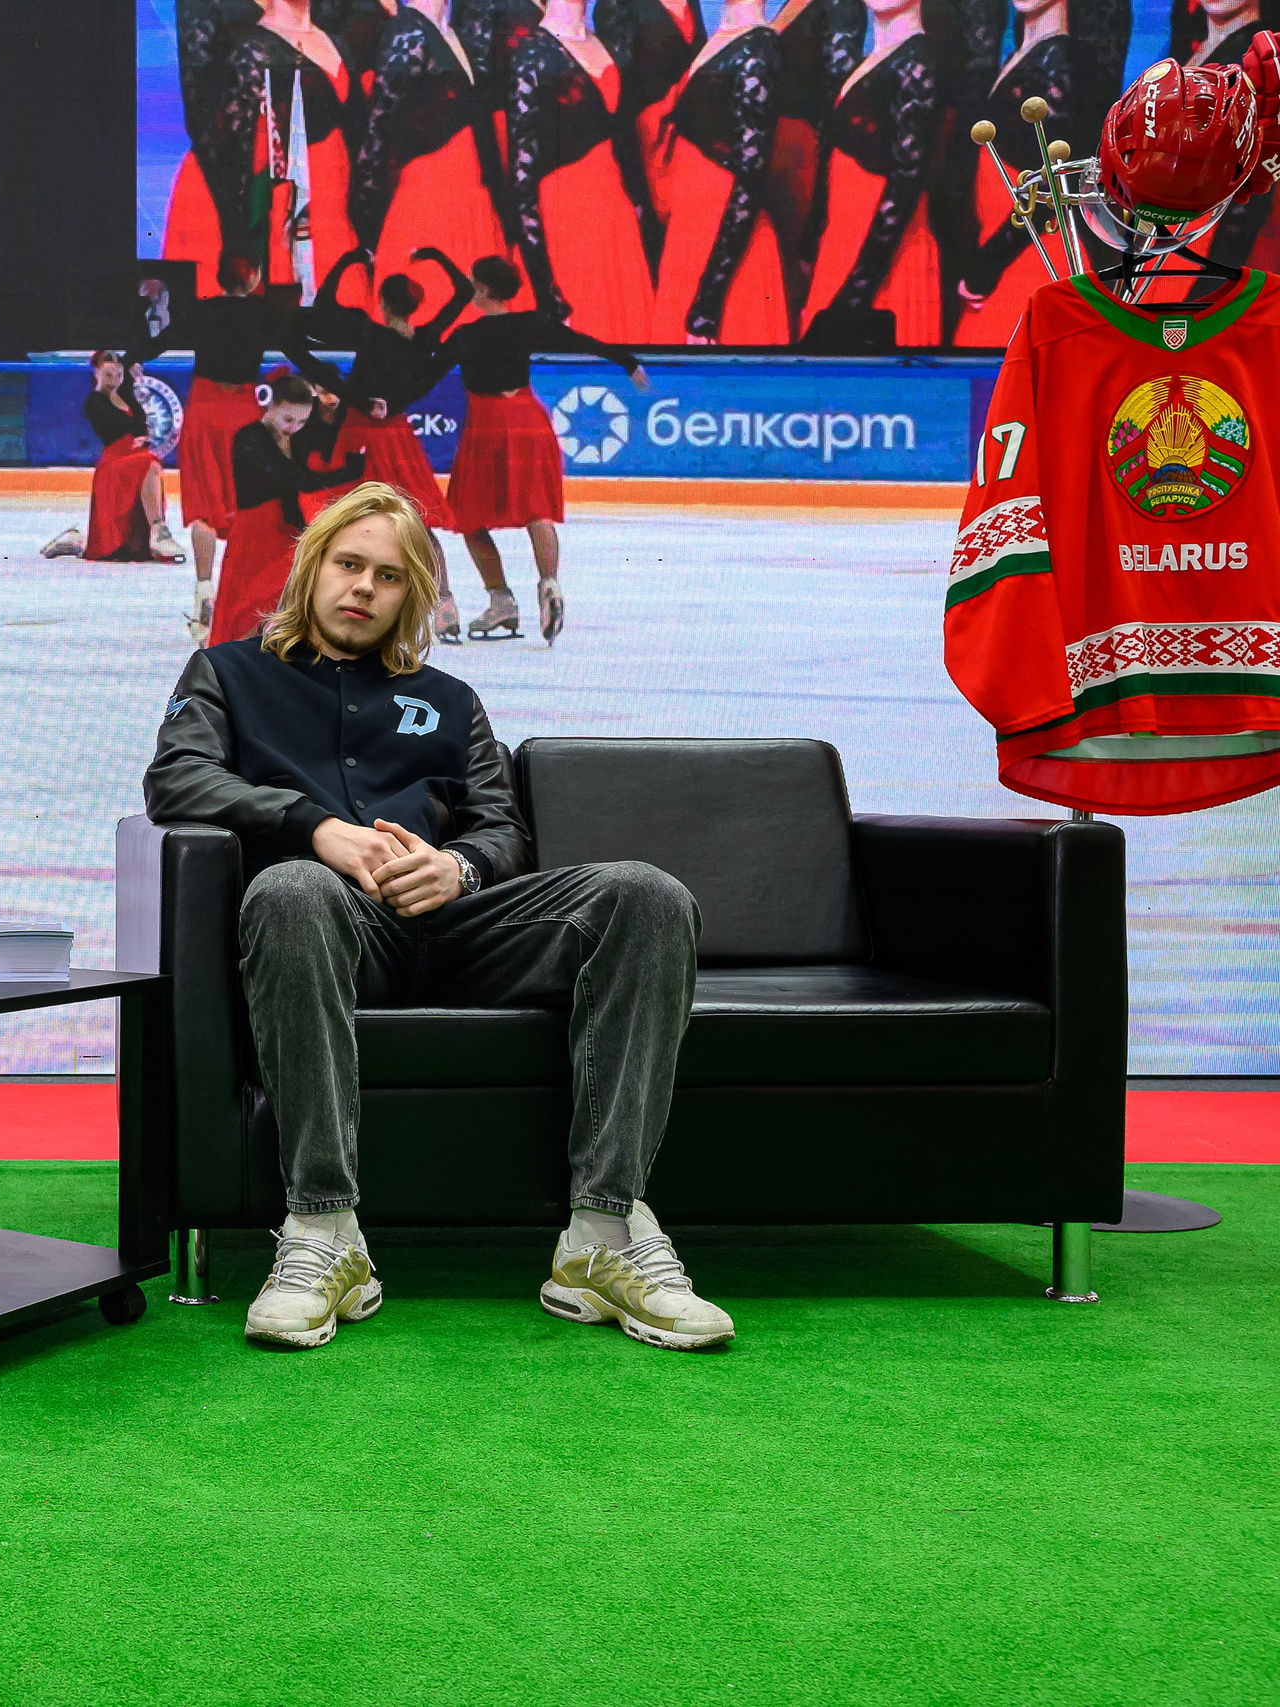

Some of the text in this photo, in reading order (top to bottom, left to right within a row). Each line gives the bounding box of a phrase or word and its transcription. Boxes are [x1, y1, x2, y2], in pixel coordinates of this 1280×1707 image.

[1144, 82, 1162, 139] CCM
[1136, 208, 1194, 222] HOCKEY.BY
[647, 398, 915, 464] белкарт
[1148, 484, 1200, 498] РЭСПУБЛІКА
[1150, 495, 1197, 507] БЕЛАРУСЬ
[1118, 541, 1249, 572] BELARUS
